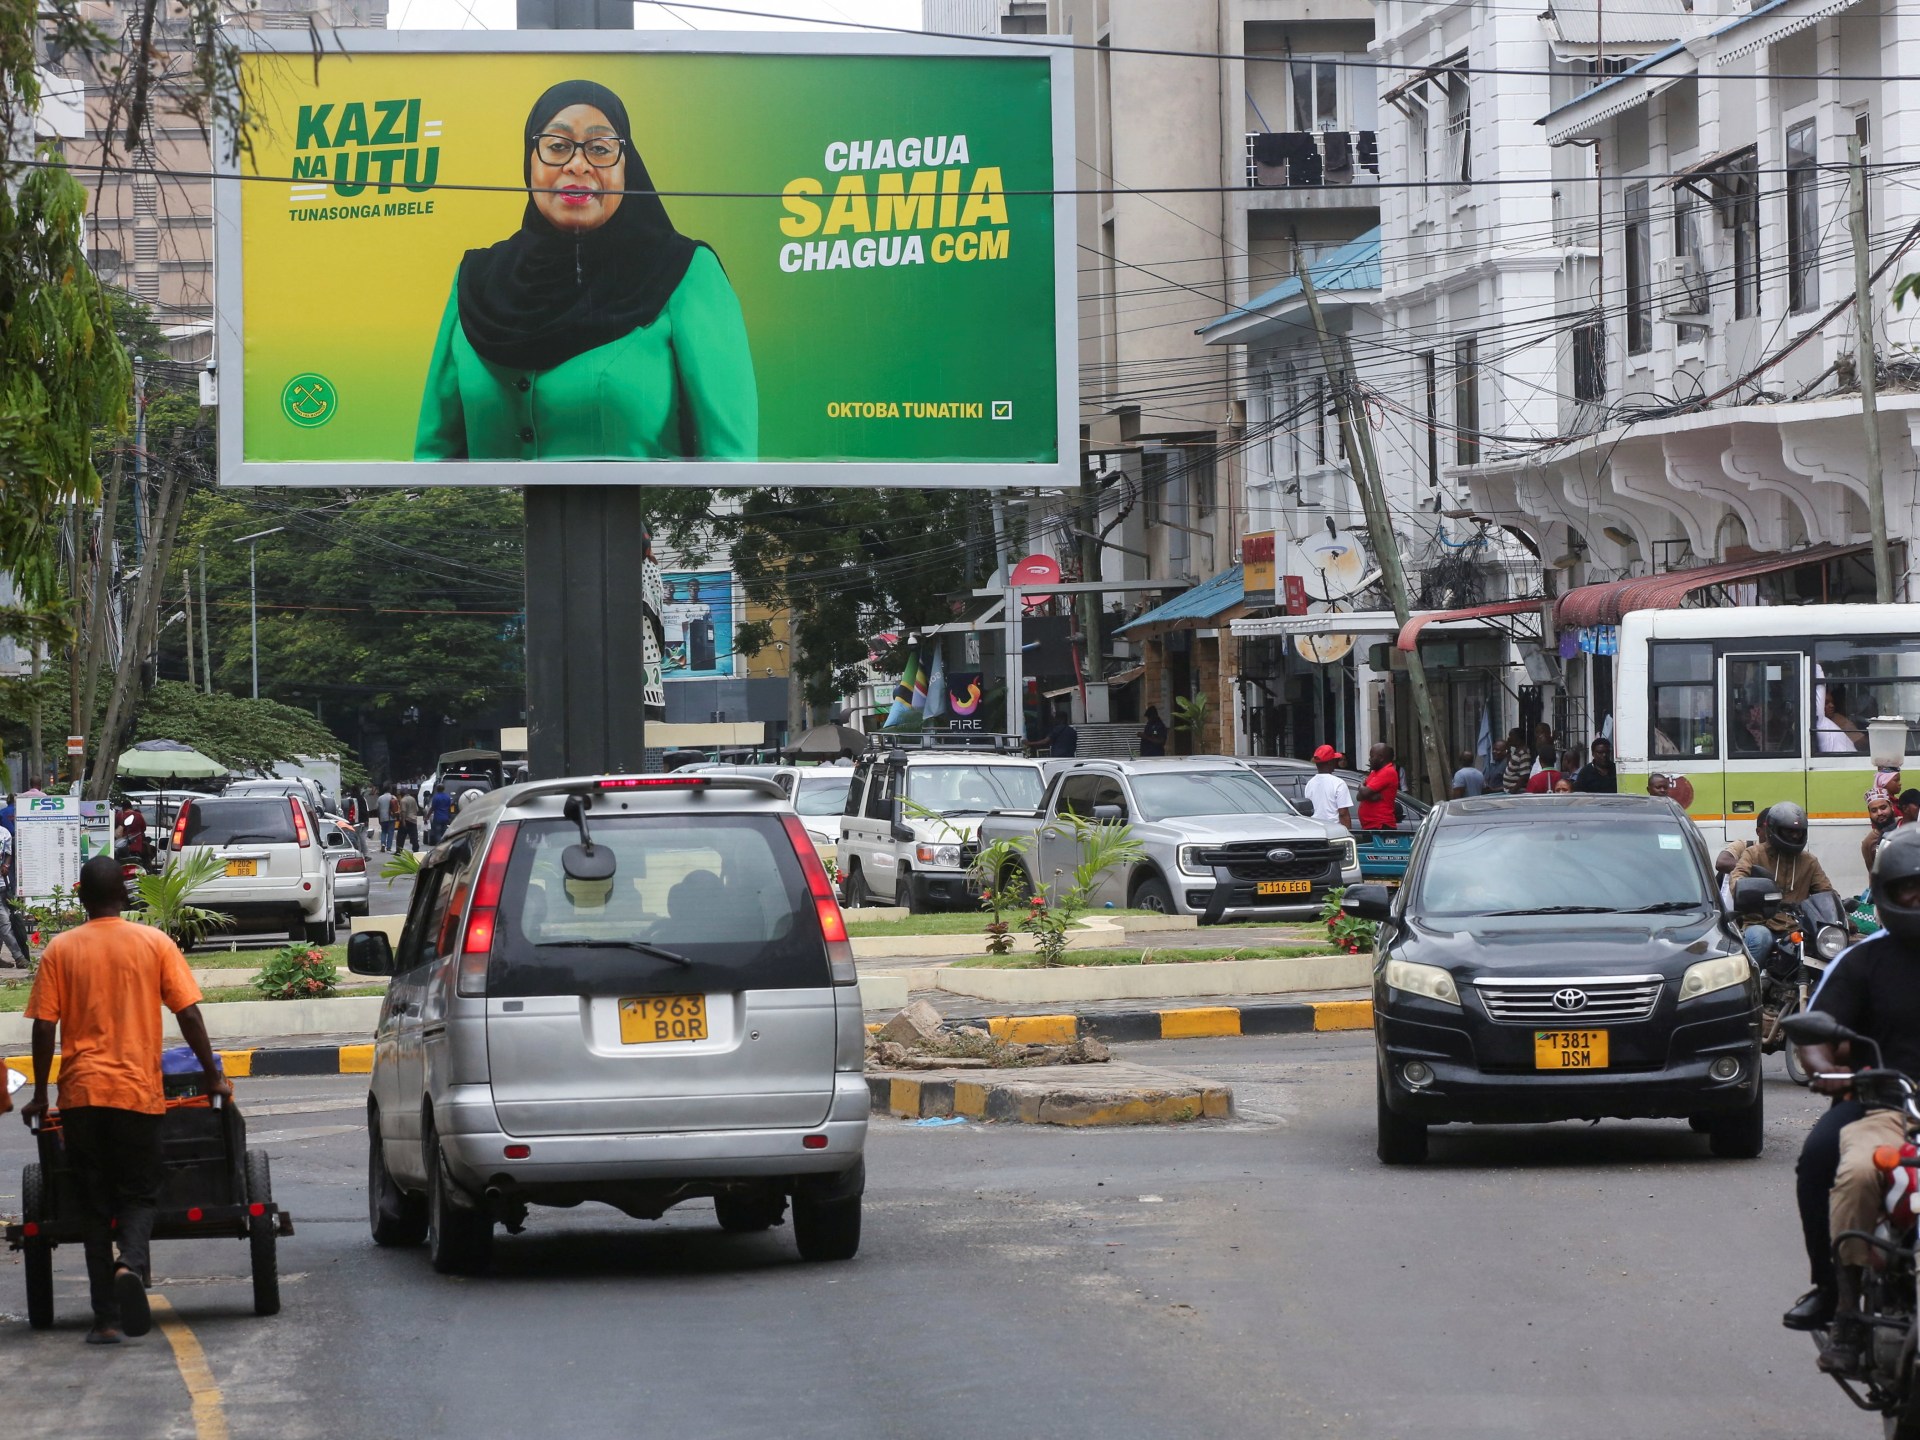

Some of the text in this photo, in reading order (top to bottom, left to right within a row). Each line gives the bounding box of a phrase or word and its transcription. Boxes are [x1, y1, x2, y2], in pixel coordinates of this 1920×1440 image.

[296, 98, 421, 150] KAZI
[824, 134, 970, 172] CHAGUA
[292, 146, 440, 198] NA UTU
[288, 201, 435, 221] TUNASONGA MBELE
[779, 166, 1009, 238] SAMIA
[779, 229, 1010, 273] CHAGUA CCM
[827, 402, 983, 418] OKTOBA TUNATIKI
[950, 719, 982, 730] FIRE
[30, 797, 65, 811] FSB
[1289, 881, 1307, 892] EEG
[636, 996, 701, 1019] T963
[655, 1018, 703, 1039] BQR
[1550, 1032, 1590, 1049] T381
[1561, 1050, 1591, 1067] DSM
